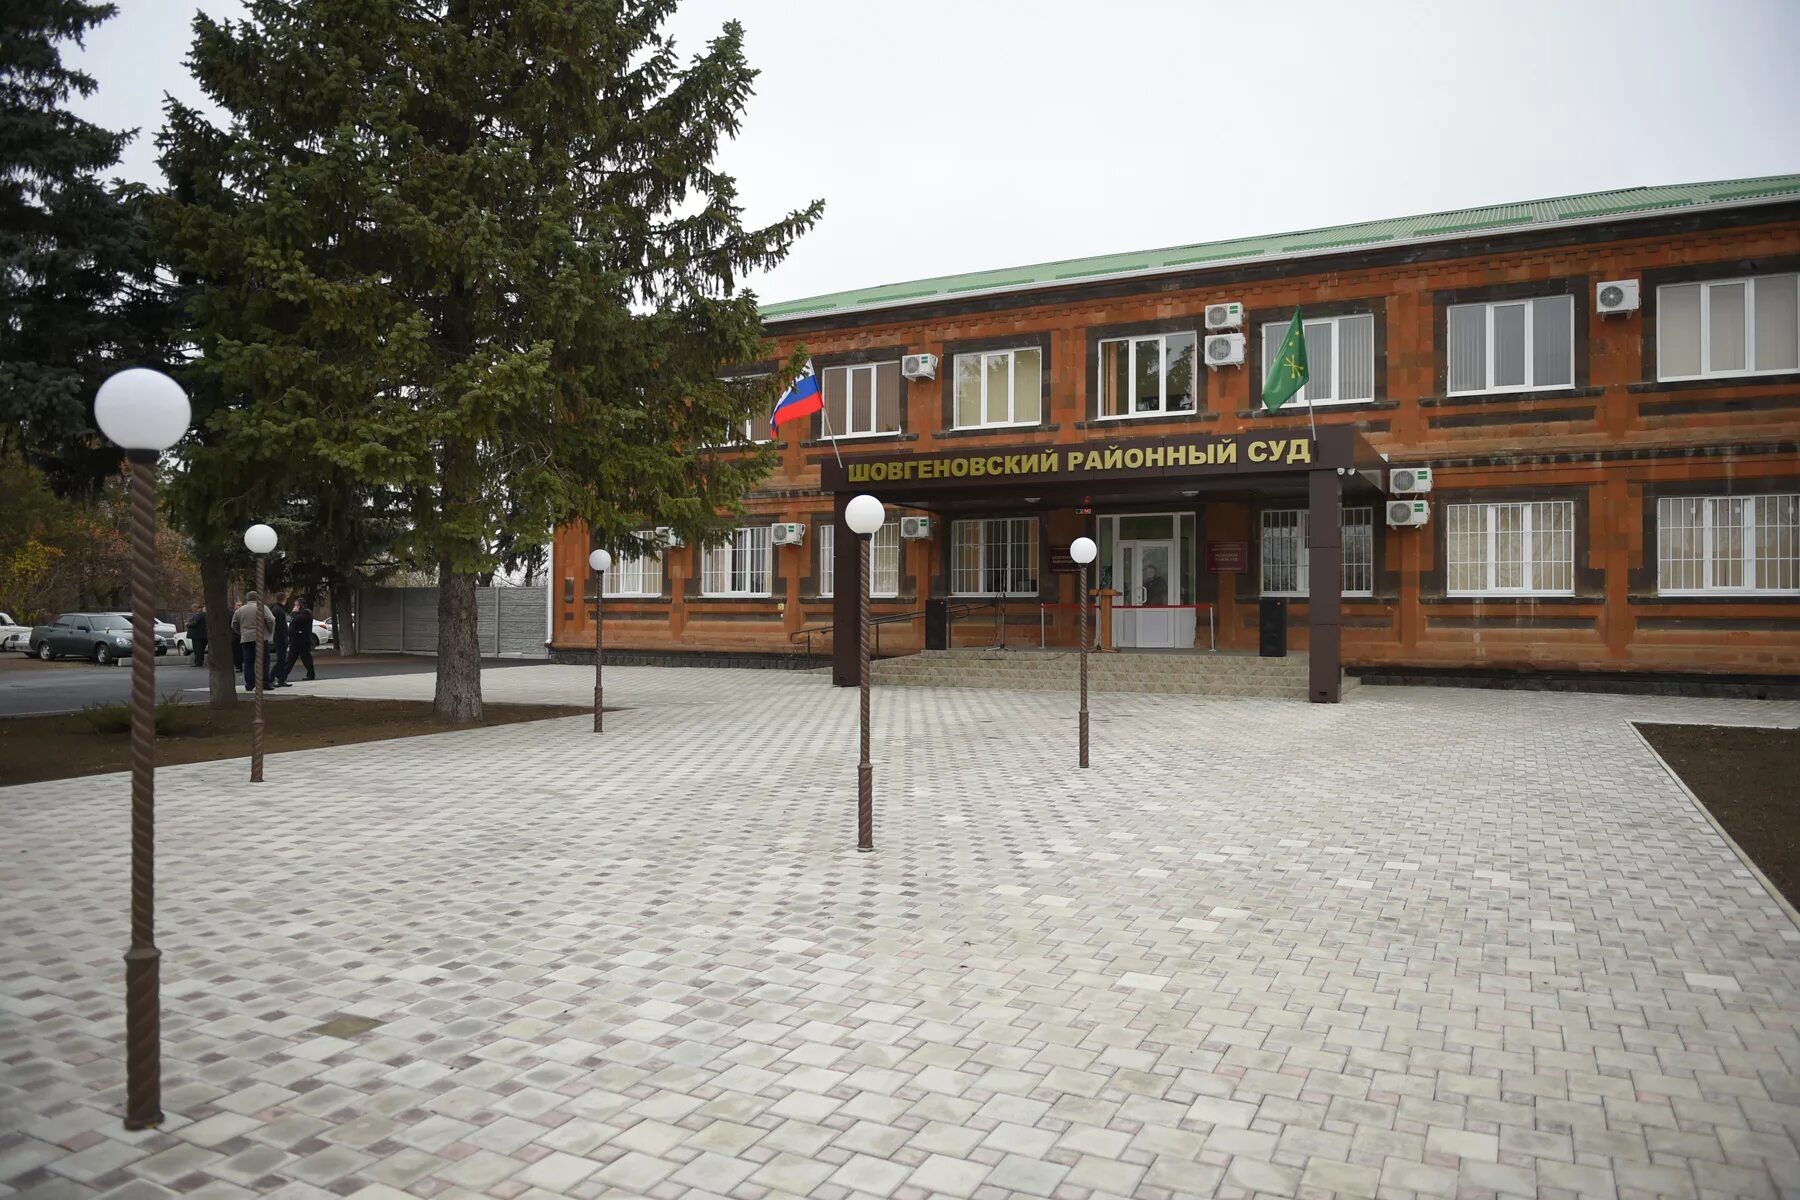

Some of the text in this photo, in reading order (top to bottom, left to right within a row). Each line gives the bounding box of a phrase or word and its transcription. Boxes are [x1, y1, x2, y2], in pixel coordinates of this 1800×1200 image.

[848, 438, 1311, 482] ШОВГЕНОВСКИЙ РАЙОННЫЙ СУД
